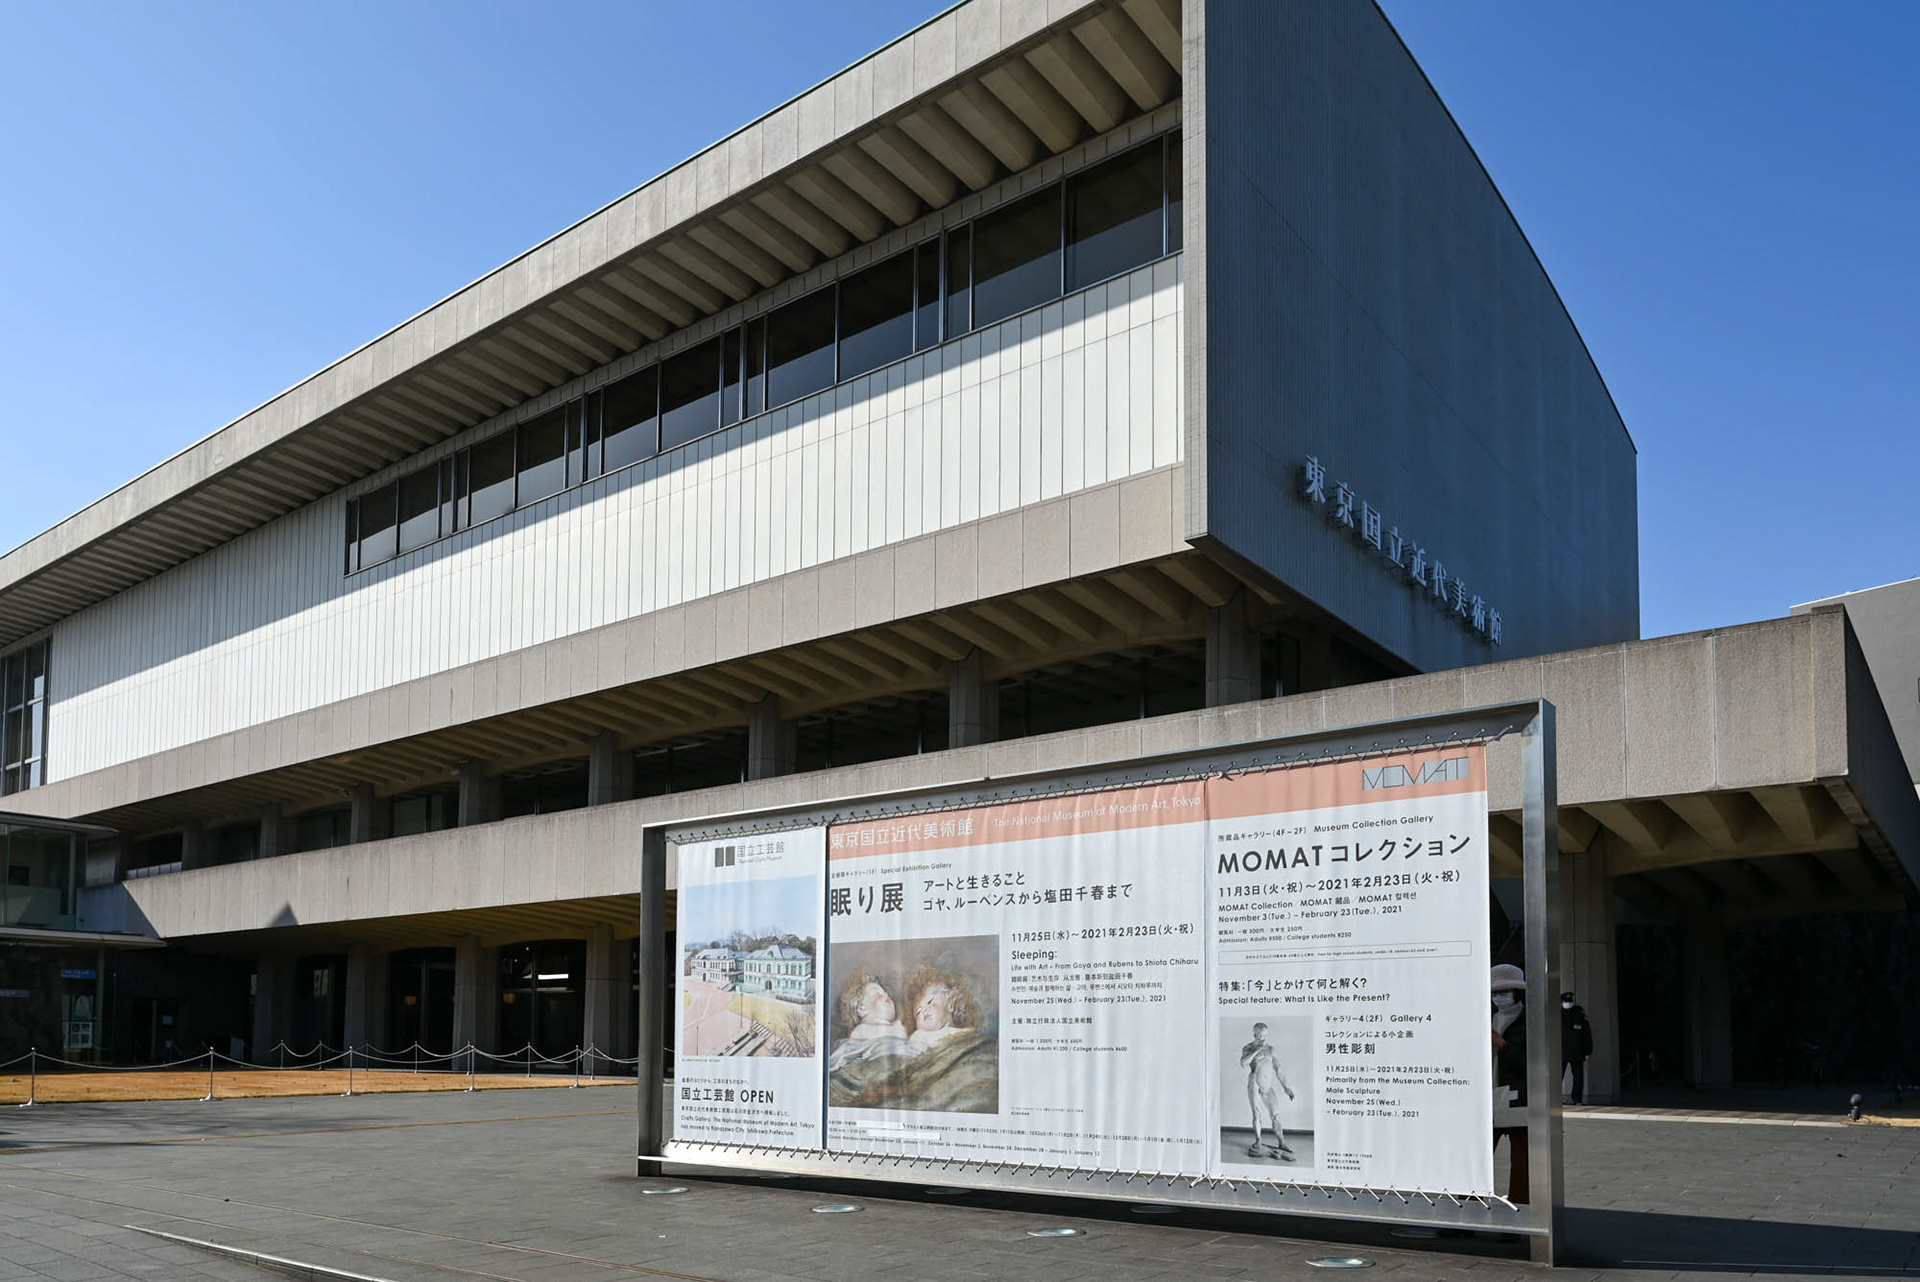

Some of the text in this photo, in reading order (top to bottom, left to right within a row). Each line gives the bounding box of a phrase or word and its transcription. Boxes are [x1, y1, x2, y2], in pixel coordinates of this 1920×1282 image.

[1306, 455, 1502, 646] 東京国立近代美術館
[1362, 757, 1470, 790] MOMAT
[1012, 814, 1050, 827] National
[1053, 809, 1093, 822] Museum
[1093, 808, 1106, 818] of
[1109, 801, 1148, 815] Modern
[1171, 796, 1202, 808] Tokyo
[1314, 823, 1350, 834] Museum
[1352, 816, 1397, 830] Collection
[1400, 813, 1434, 826] Gallery
[830, 818, 974, 849] 東京国立近代美術館
[737, 841, 784, 857] 国立工芸館
[881, 867, 902, 875] Special
[902, 862, 930, 873] Exhibition
[931, 861, 952, 871] Gallery
[924, 871, 1026, 892] アートと生きること
[830, 882, 904, 917] 眠り展
[923, 883, 1133, 911] ゴヤ、ルーベンスから塩田千春まで
[1219, 903, 1248, 912] MOMAT
[1251, 900, 1293, 911] Collection
[1300, 898, 1333, 907] MOMAT
[1358, 894, 1392, 903] MOMAT
[1218, 914, 1260, 923] November
[1301, 908, 1338, 918] February
[1382, 905, 1402, 914] 2021
[1012, 949, 1058, 960] Sleeping:
[1073, 962, 1091, 970] Goya
[1108, 960, 1134, 968] Rubens
[1169, 957, 1199, 965] Chiharu
[1084, 996, 1114, 1004] February
[1218, 993, 1390, 1005] Special feature: What Is Like the Present?
[1390, 1014, 1423, 1024] Gallery
[1426, 1014, 1432, 1022] 4
[1325, 1030, 1413, 1039] コレクションによる小企画
[1326, 1043, 1375, 1054] 男性彫刻
[1326, 1076, 1470, 1086] Primarily from the Museum Collection:
[682, 1086, 774, 1104] 国立工芸館 OPEN
[1346, 1087, 1381, 1096] Sculpture
[1326, 1097, 1364, 1105] November
[1332, 1108, 1365, 1117] February
[1401, 1110, 1420, 1118] 2021
[799, 1121, 815, 1129] Tokyo
